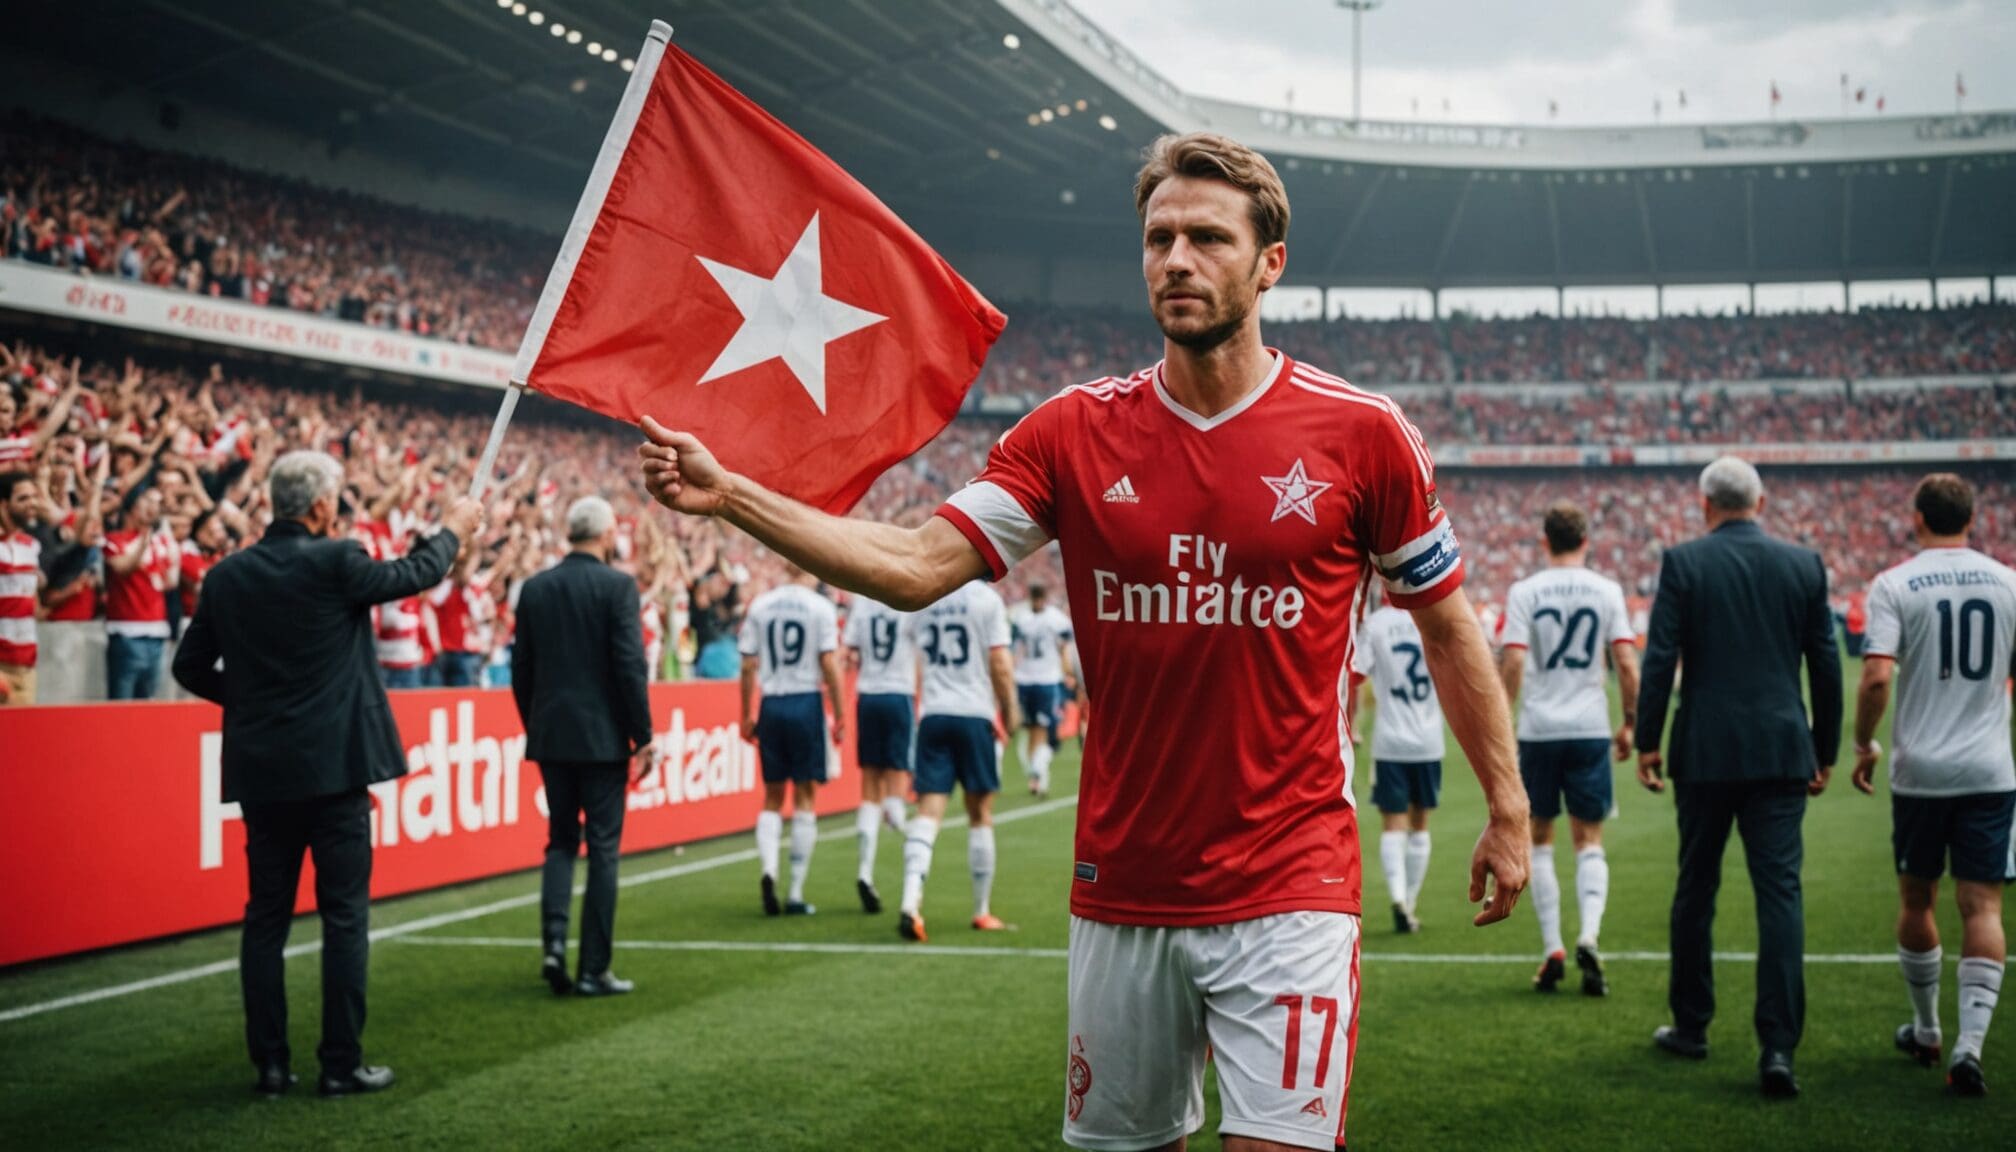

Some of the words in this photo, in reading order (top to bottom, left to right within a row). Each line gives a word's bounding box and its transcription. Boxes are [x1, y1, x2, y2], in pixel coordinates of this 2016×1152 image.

[1168, 533, 1228, 578] Fly
[767, 617, 805, 675] 19
[1936, 597, 1995, 681] 10
[1273, 994, 1338, 1091] 17
